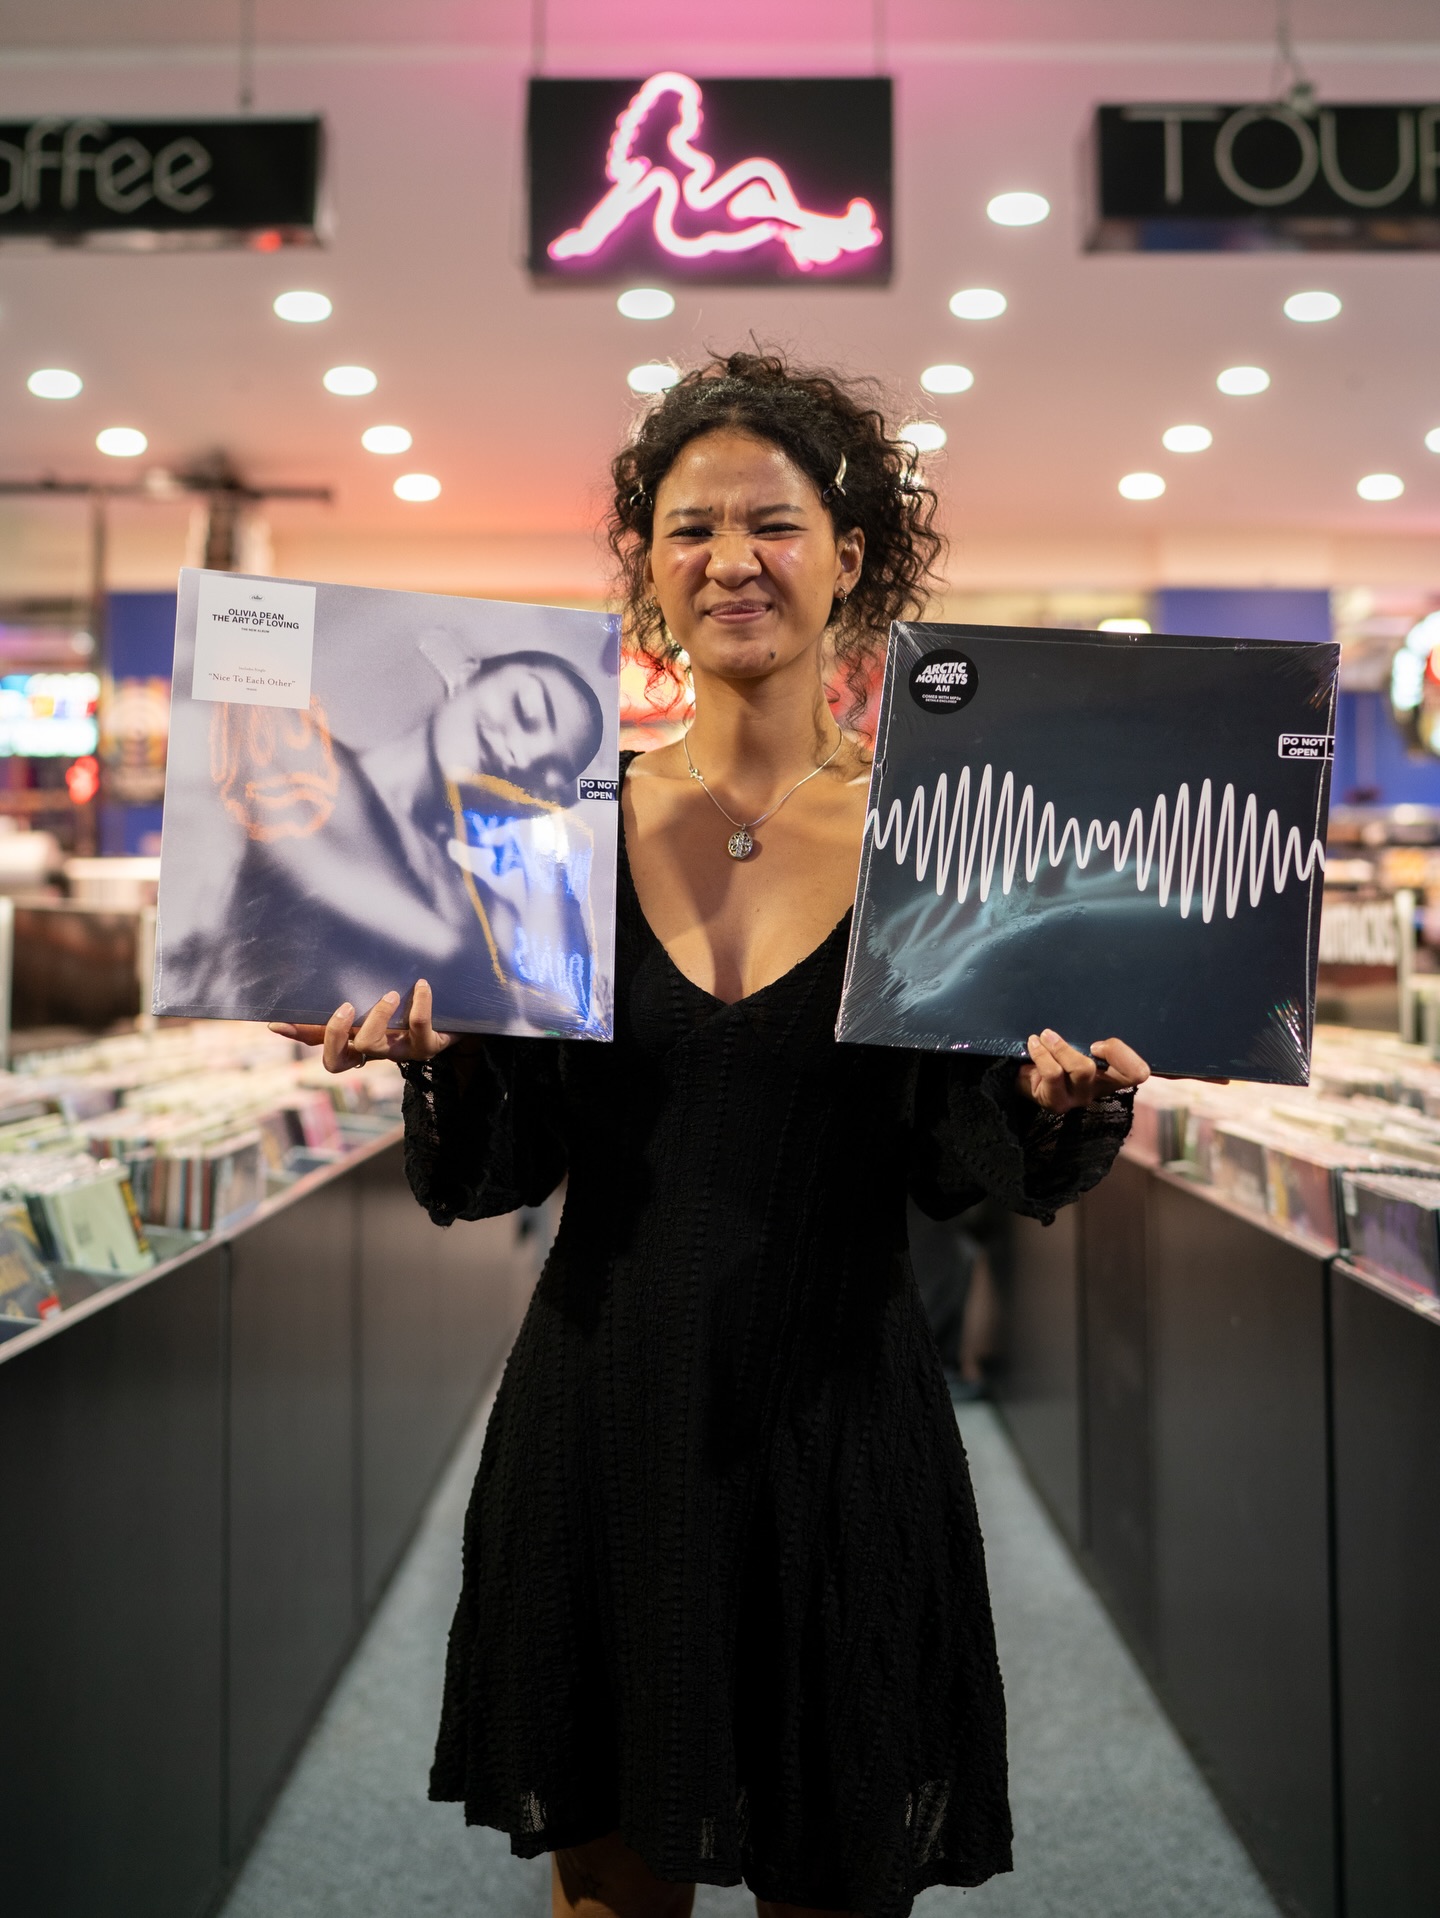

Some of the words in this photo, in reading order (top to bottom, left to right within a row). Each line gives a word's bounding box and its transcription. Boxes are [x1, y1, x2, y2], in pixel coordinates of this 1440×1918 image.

[228, 608, 258, 618] OLIVIA
[259, 611, 285, 621] DEAN
[212, 613, 230, 622] THE
[232, 616, 250, 624] ART
[252, 618, 264, 626] OF
[266, 619, 300, 630] LOVING
[922, 662, 967, 675] ARCTIC
[233, 674, 244, 683] To
[246, 676, 265, 685] Each
[915, 673, 968, 685] MONKEYS
[935, 684, 950, 692] AM
[1283, 737, 1299, 746] DO
[1301, 738, 1325, 747] NOT
[1288, 747, 1319, 756] OPEN
[580, 780, 595, 788] DO
[597, 781, 618, 790] NOT
[586, 790, 613, 799] OPEN
